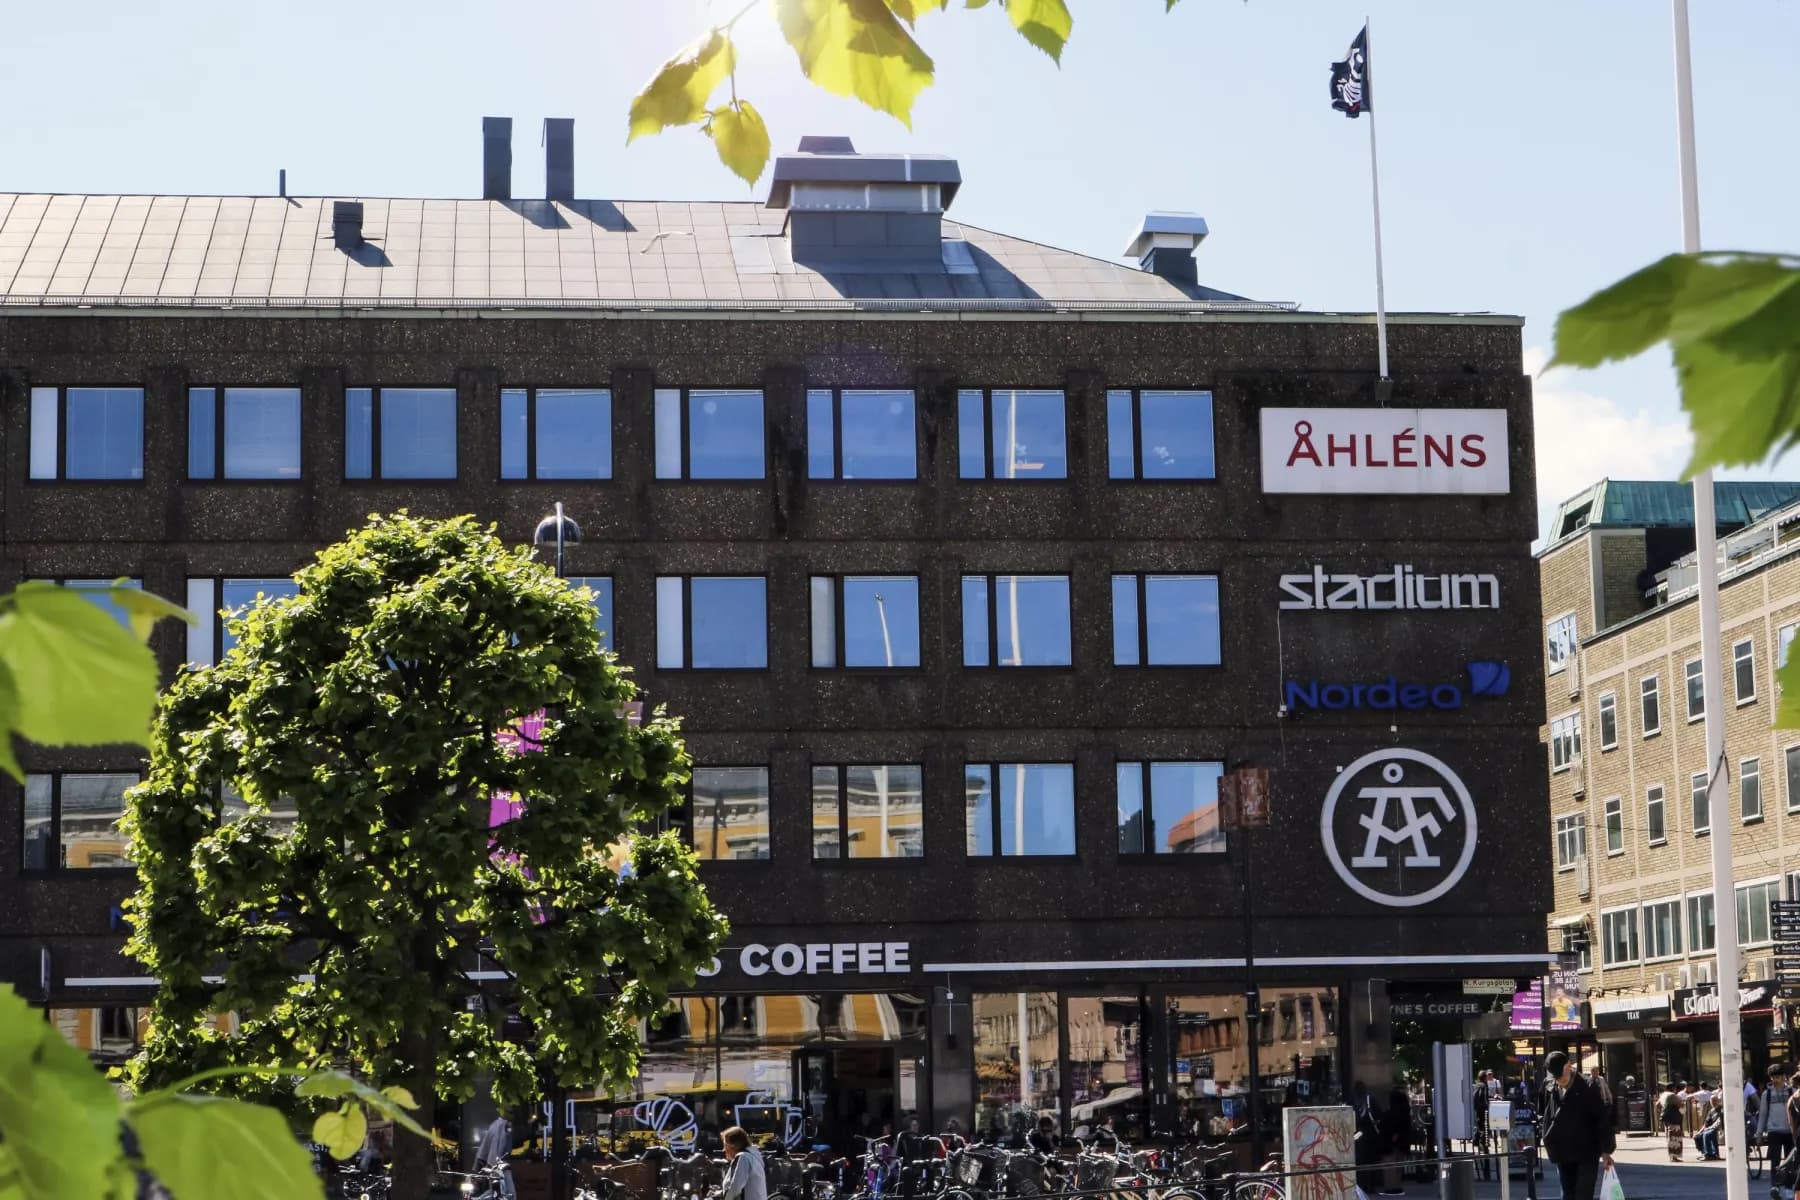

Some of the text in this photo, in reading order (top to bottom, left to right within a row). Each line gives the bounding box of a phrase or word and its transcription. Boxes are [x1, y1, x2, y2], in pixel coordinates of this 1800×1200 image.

[1286, 420, 1487, 468] ÅHLÉNS
[1278, 564, 1500, 609] stadium
[1285, 675, 1462, 712] Nordea
[740, 942, 911, 976] COFFEE
[1428, 1003, 1480, 1014] COFFEE
